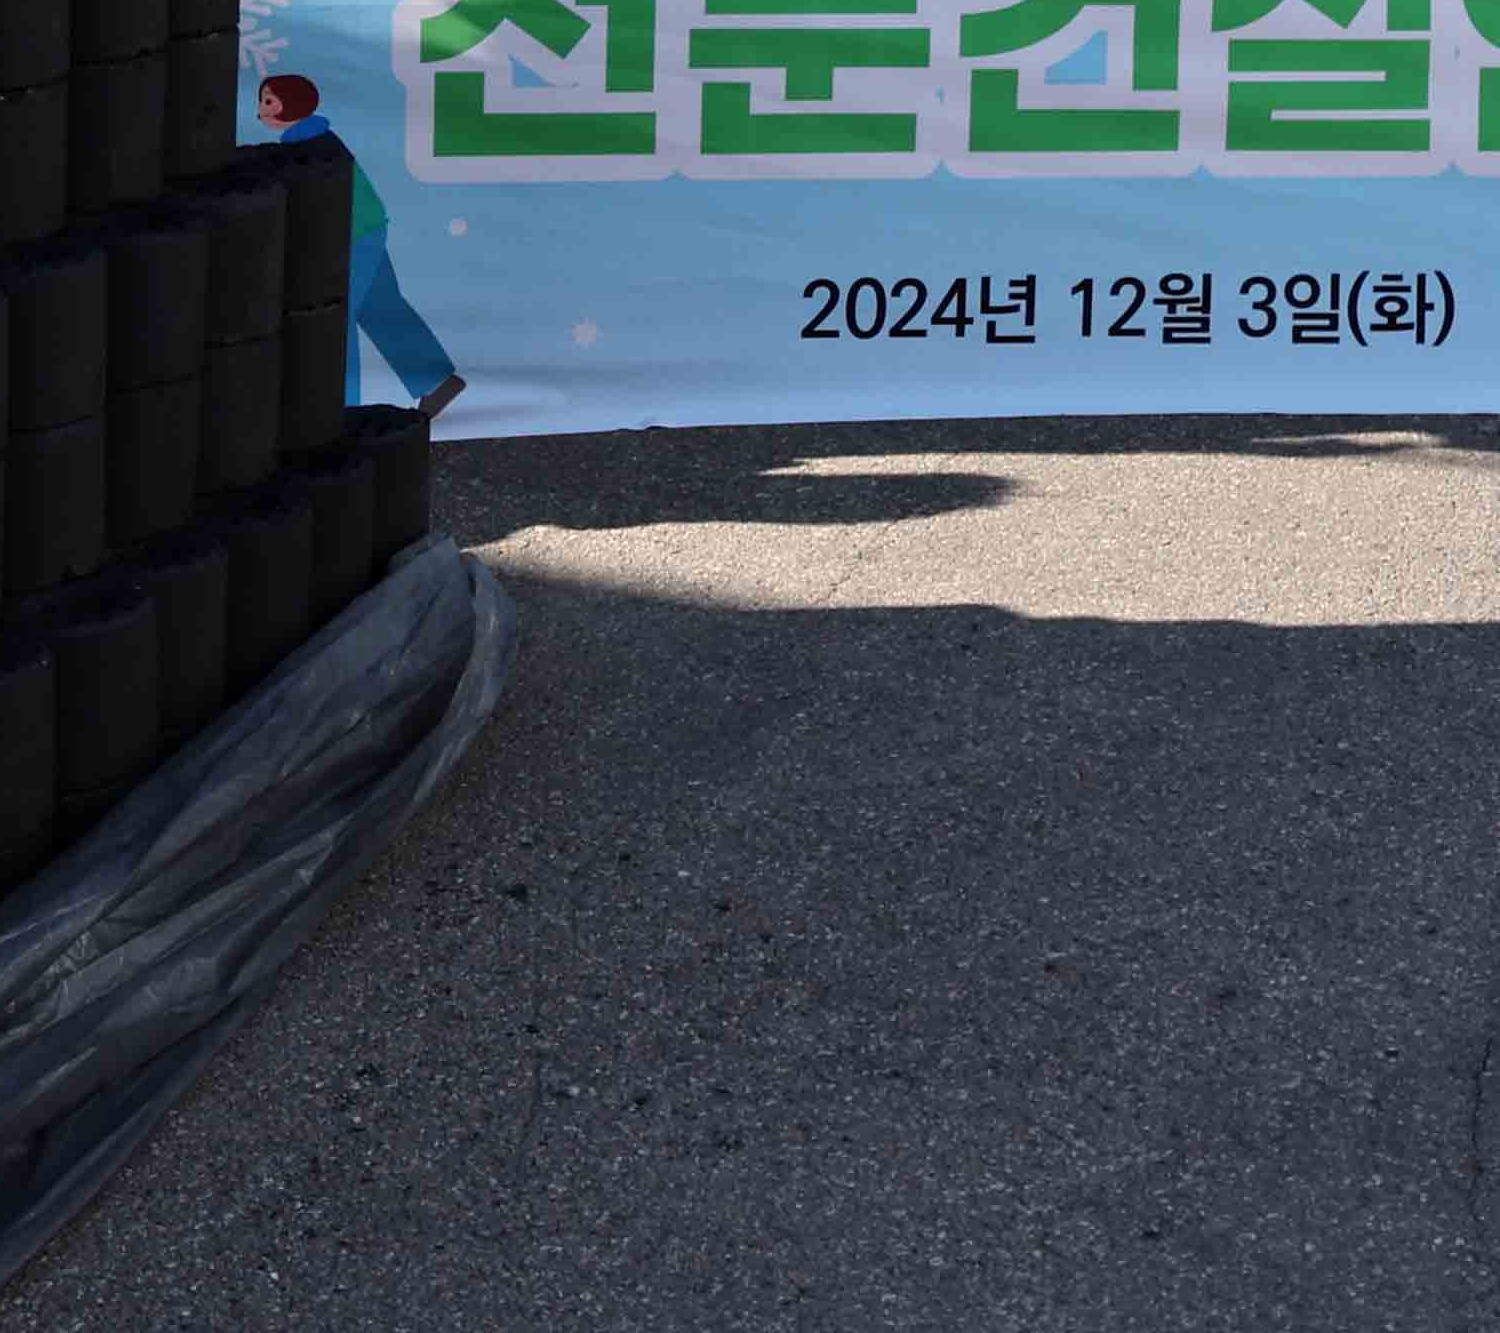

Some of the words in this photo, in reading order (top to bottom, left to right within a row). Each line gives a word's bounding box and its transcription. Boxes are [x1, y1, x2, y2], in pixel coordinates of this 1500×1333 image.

[800, 274, 1037, 344] 2024년
[1071, 273, 1212, 344] 12월
[1238, 270, 1455, 347] 3일(화)
